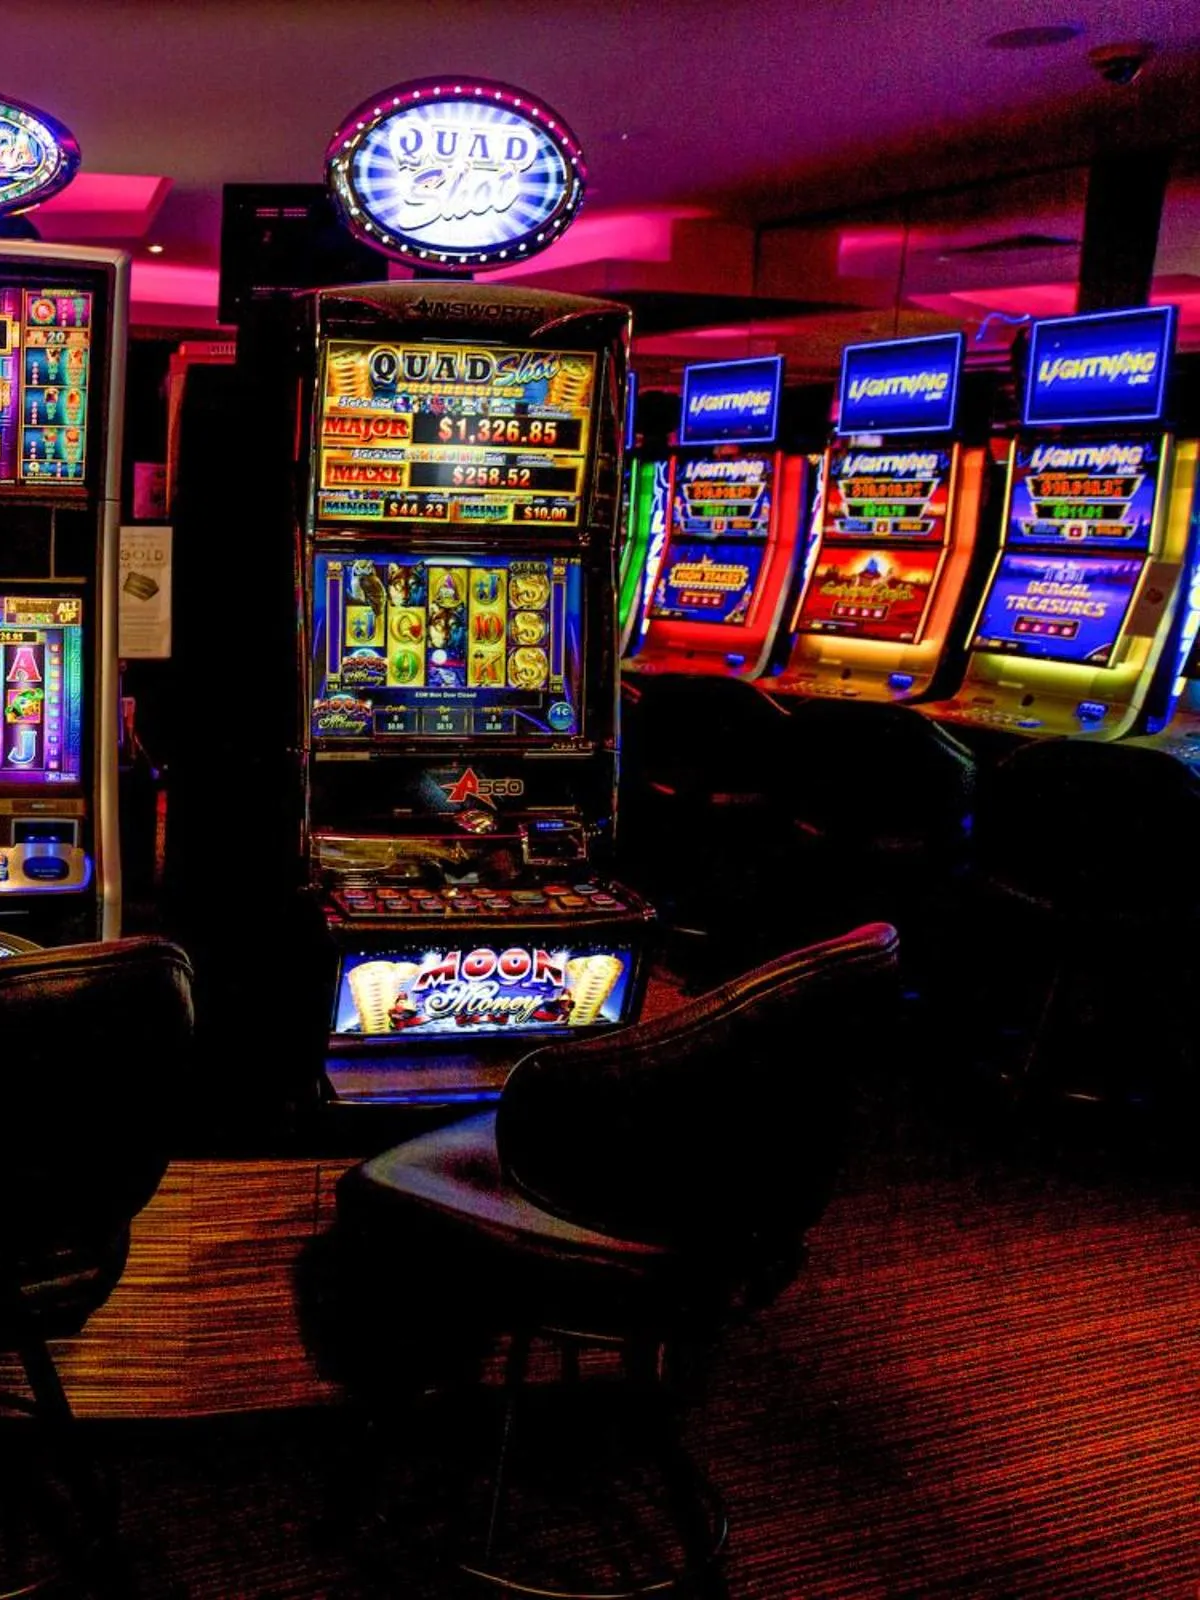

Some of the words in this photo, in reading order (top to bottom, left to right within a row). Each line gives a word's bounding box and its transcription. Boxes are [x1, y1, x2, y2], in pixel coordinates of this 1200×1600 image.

[399, 127, 529, 167] QUAD
[401, 164, 522, 228] Shot
[47, 331, 65, 344] 20
[370, 346, 494, 389] QUAD
[494, 351, 561, 386] Shot
[1037, 350, 1158, 388] LIGHTNING
[848, 371, 949, 404] LIGHTNING
[689, 389, 772, 417] LIGHTNING
[325, 416, 409, 442] MAJOR
[438, 418, 557, 444] $1,326.85
[685, 459, 765, 482] LIGHTNING
[842, 452, 939, 478] LIGHTNING
[1029, 443, 1144, 473] LIGHTNING
[452, 467, 531, 487] $258.52
[323, 501, 381, 516] MINOR
[388, 503, 444, 517] $44.23
[523, 507, 568, 520] $10.00
[120, 549, 165, 562] GOLD
[1027, 580, 1092, 599] BENGAL
[57, 601, 79, 614] ALL
[60, 612, 77, 623] UP
[1006, 595, 1107, 617] TREASURES
[474, 612, 504, 645] 10
[6, 647, 42, 683] A
[8, 730, 38, 764] J
[412, 947, 568, 991] MOON
[423, 979, 547, 1022] Money
